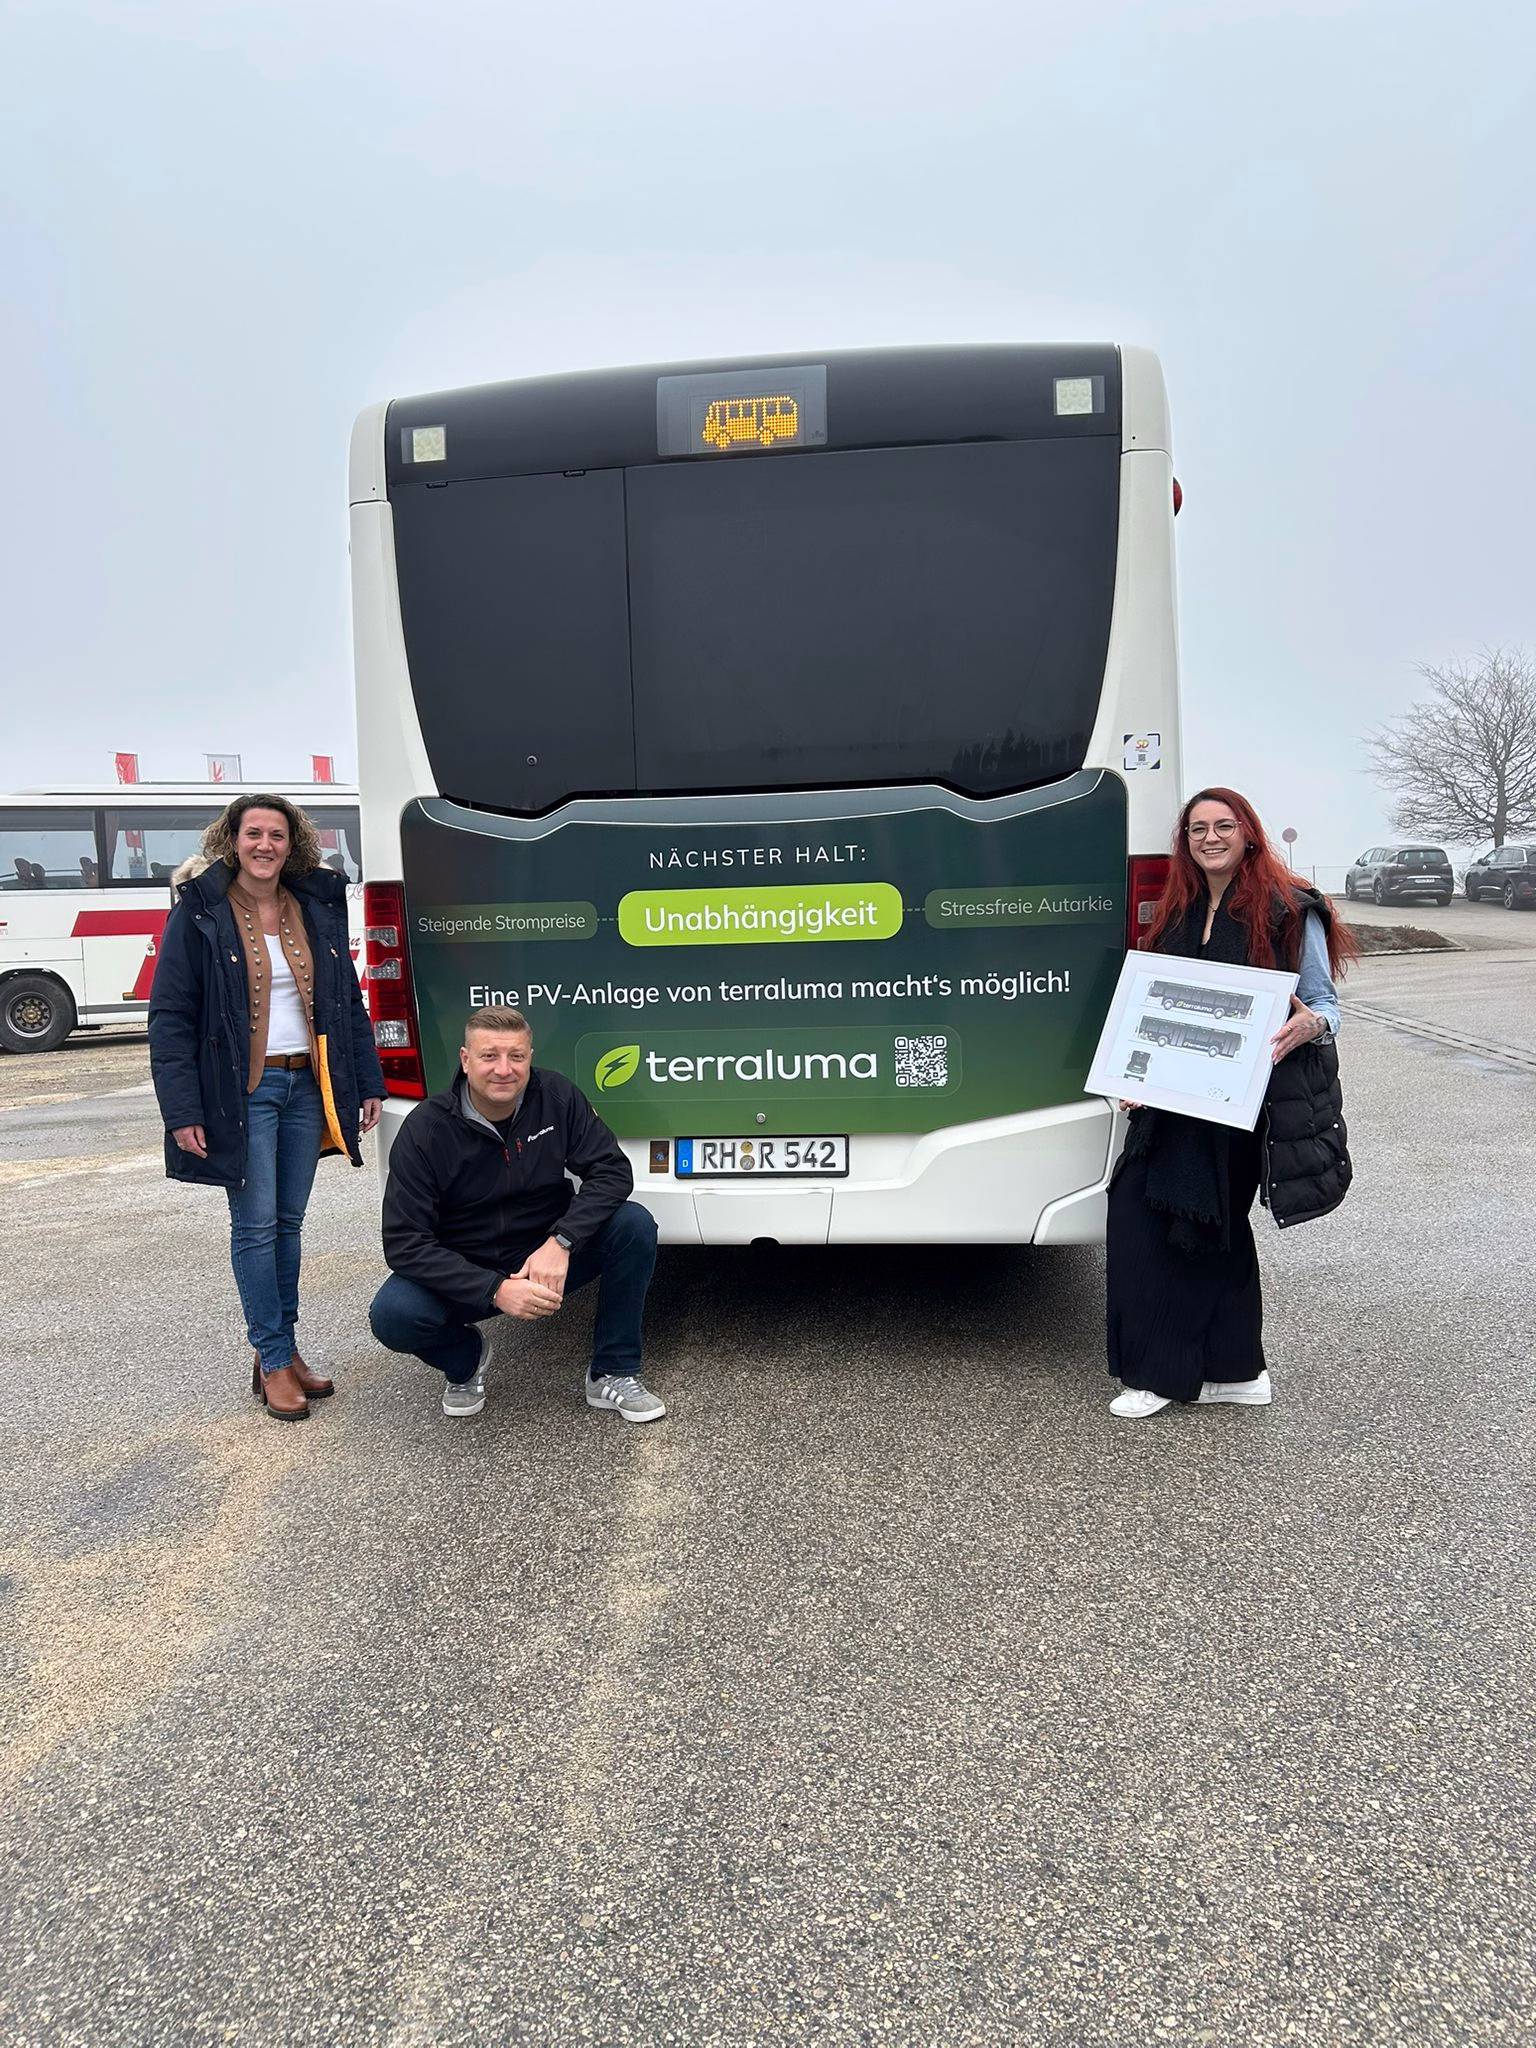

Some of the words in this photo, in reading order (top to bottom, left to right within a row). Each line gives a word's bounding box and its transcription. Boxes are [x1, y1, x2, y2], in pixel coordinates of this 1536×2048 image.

[649, 848, 783, 869] NÄCHSTER
[796, 845, 867, 863] HALT:
[644, 901, 878, 935] Unabhängigkeit
[940, 899, 1033, 917] Stressfreie
[1037, 895, 1113, 914] Autarkie
[418, 916, 492, 935] Steigende
[495, 913, 586, 932] Strompreise
[469, 986, 519, 1007] Eine
[527, 982, 659, 1009] PV-Anlage
[666, 987, 712, 1002] von
[719, 978, 843, 1001] terraluma
[960, 971, 1071, 1000] möglich!
[645, 1049, 878, 1082] terraluma
[682, 1160, 689, 1168] D
[702, 1142, 736, 1169] RH
[760, 1142, 775, 1168] R
[785, 1141, 837, 1168] 542
